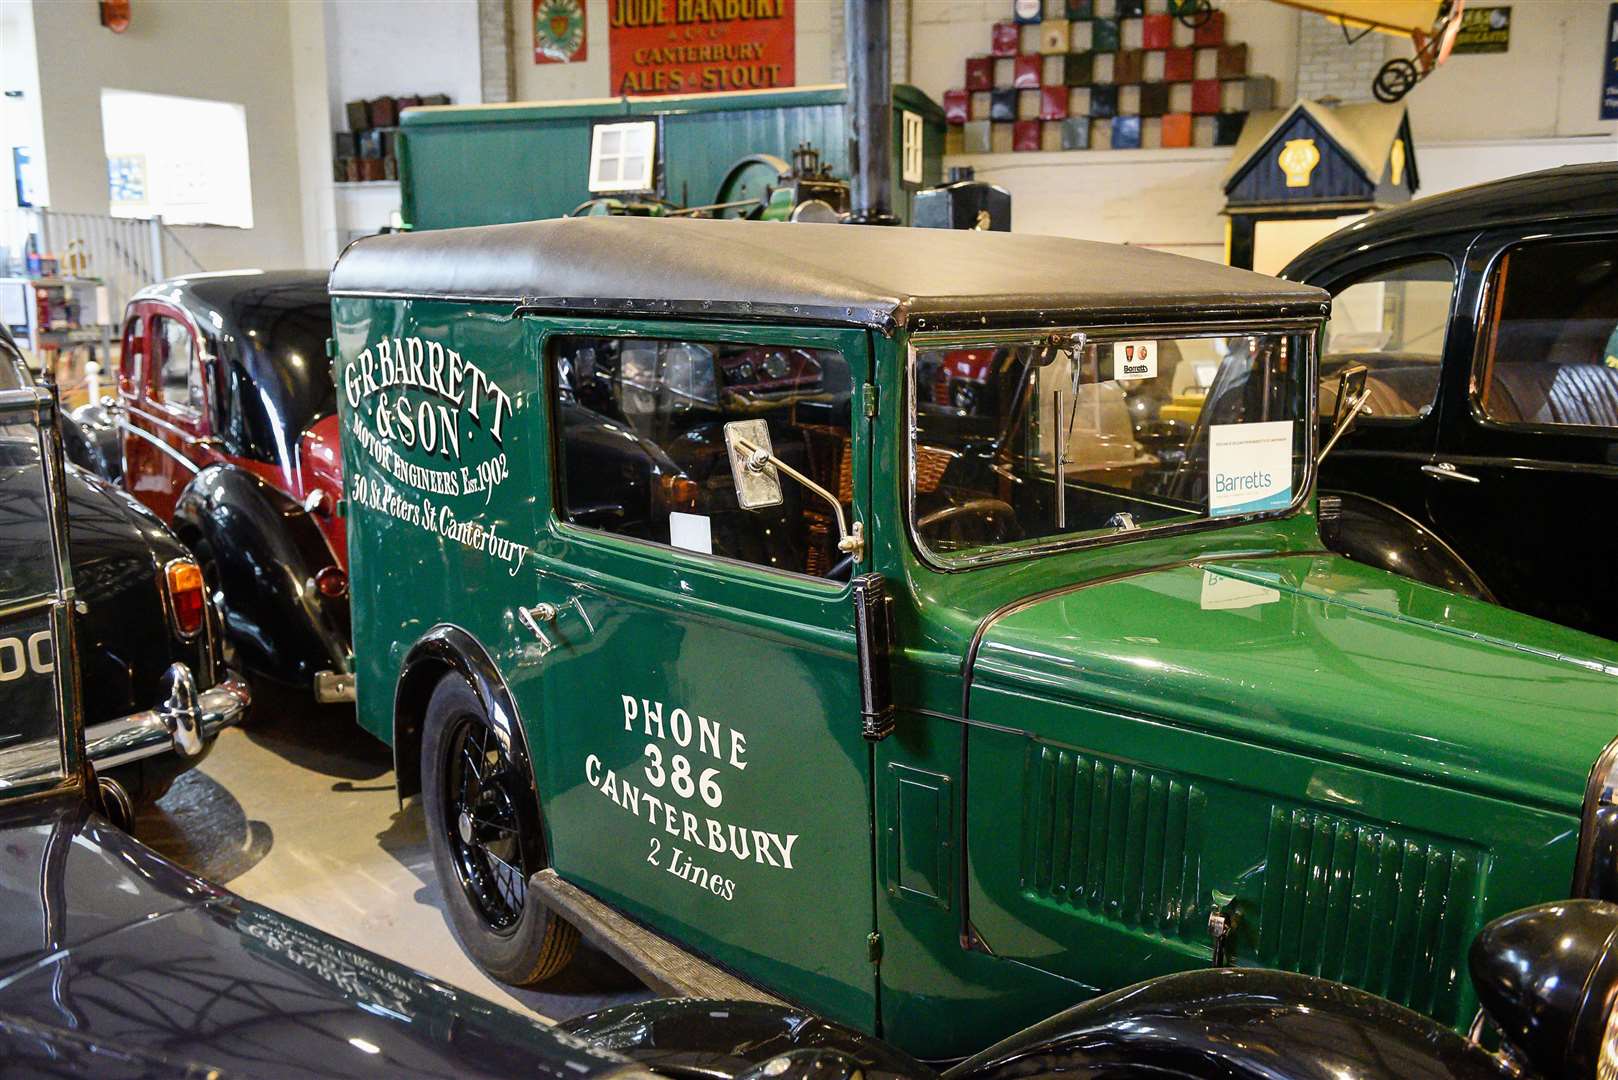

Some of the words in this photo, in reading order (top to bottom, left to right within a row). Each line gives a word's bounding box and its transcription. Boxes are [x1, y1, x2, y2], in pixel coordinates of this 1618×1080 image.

[610, 0, 670, 27] JUDE
[676, 0, 784, 22] HANBURY
[622, 68, 684, 92] ALES
[702, 65, 782, 88] STOUT
[634, 43, 766, 65] CANTERBURY
[352, 412, 393, 473] MOTOR
[393, 452, 460, 496] ENGINEERS
[1215, 471, 1272, 493] Barretts
[439, 505, 529, 577] Canterbury
[621, 694, 748, 771] PHONE
[644, 743, 723, 808] 386
[585, 754, 799, 870] CANTERBURY
[646, 837, 661, 867] 2
[666, 847, 736, 902] Lines
